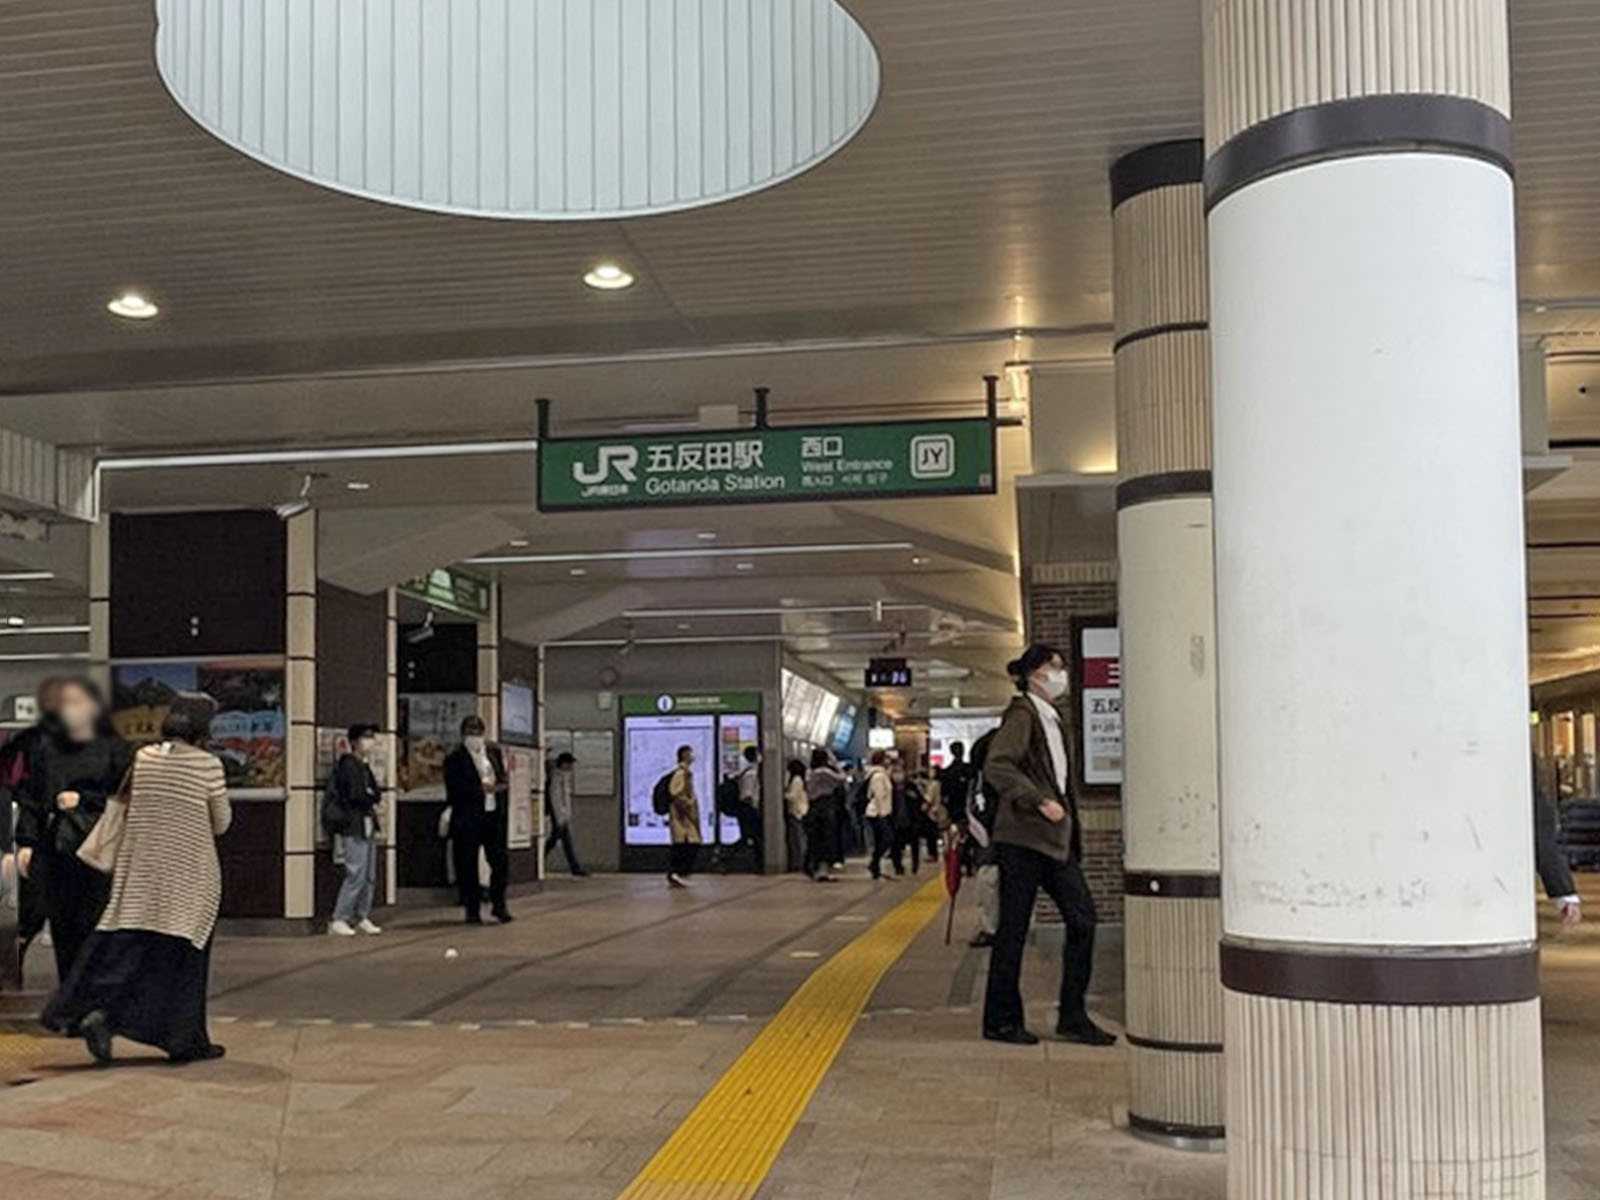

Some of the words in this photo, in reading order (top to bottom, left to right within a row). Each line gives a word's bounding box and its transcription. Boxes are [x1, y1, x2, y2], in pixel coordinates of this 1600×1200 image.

[646, 440, 764, 472] 五反田駅
[802, 436, 843, 457] 西口
[922, 448, 943, 465] JY
[573, 445, 638, 484] JR
[802, 460, 834, 473] West
[836, 458, 893, 471] Entrance
[645, 476, 719, 494] Gotanda
[725, 473, 785, 491] Station
